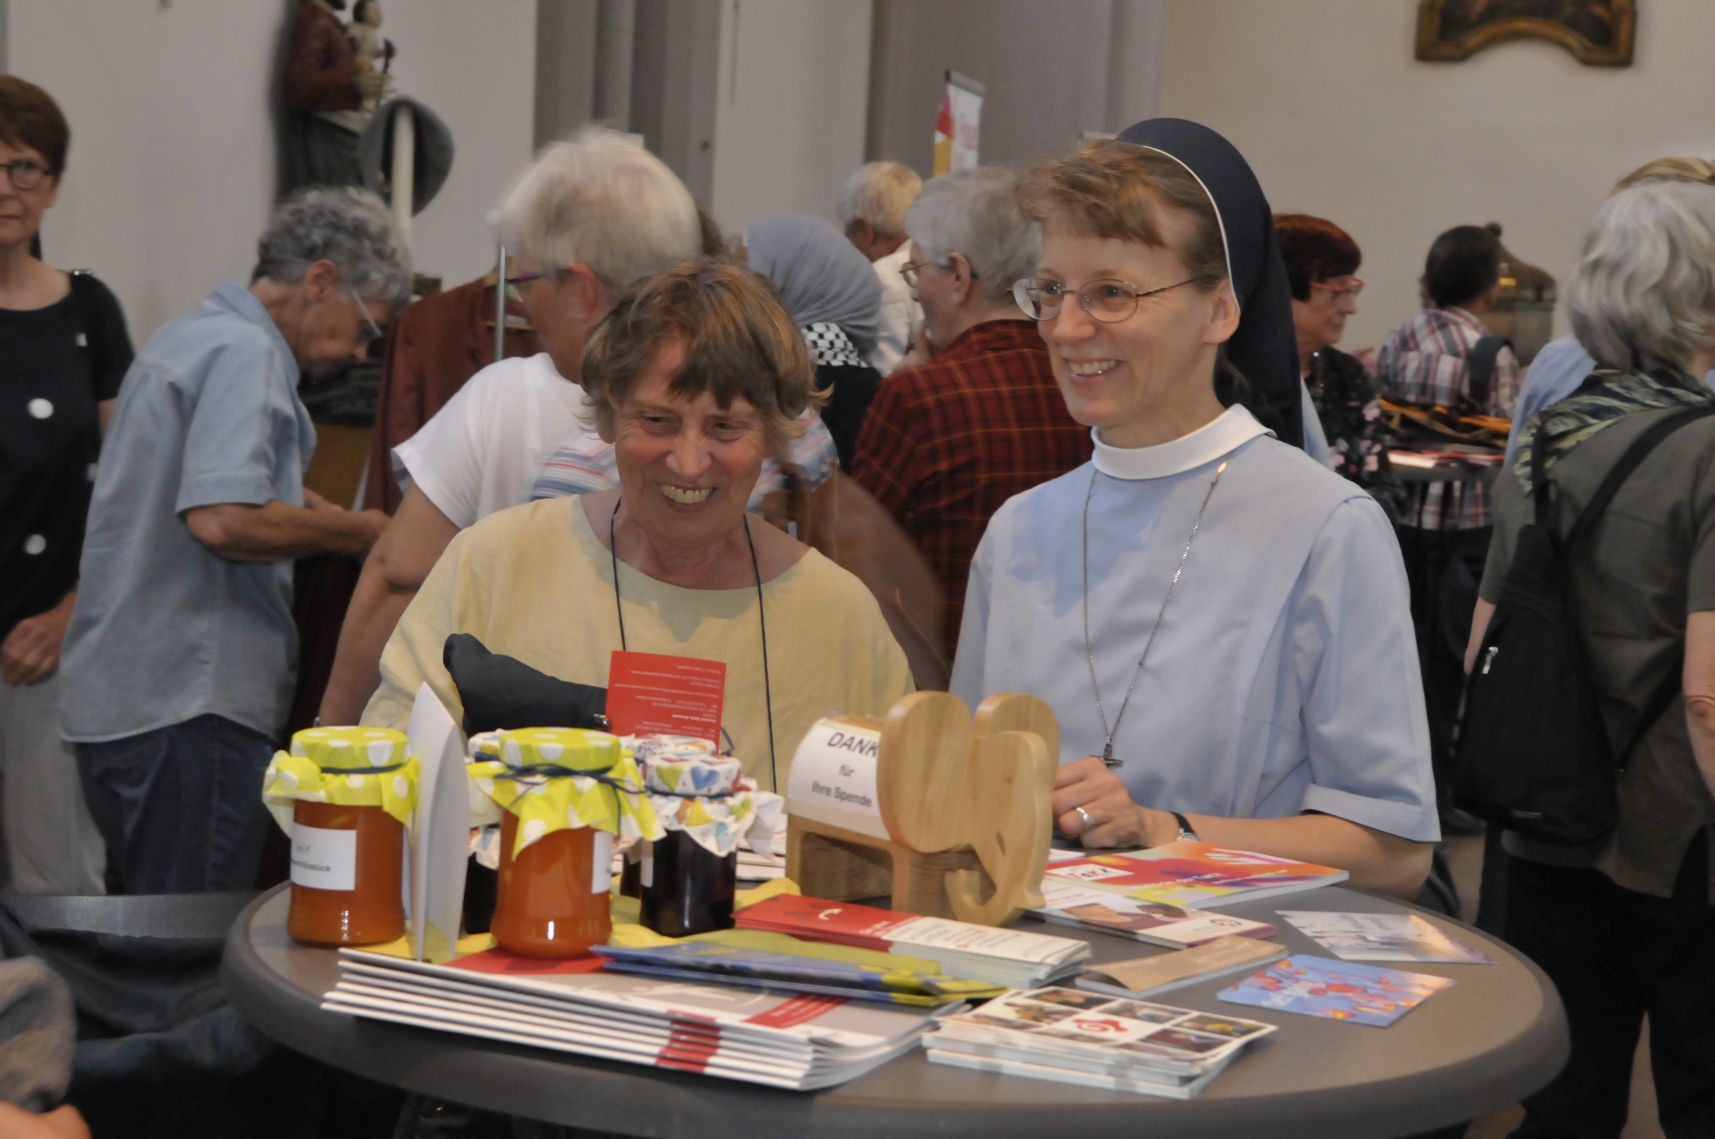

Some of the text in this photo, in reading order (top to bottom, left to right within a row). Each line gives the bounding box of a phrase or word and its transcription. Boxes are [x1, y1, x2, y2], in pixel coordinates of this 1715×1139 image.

[827, 732, 880, 757] DANK
[839, 764, 855, 777] für
[811, 780, 872, 807] Ihre Spende
